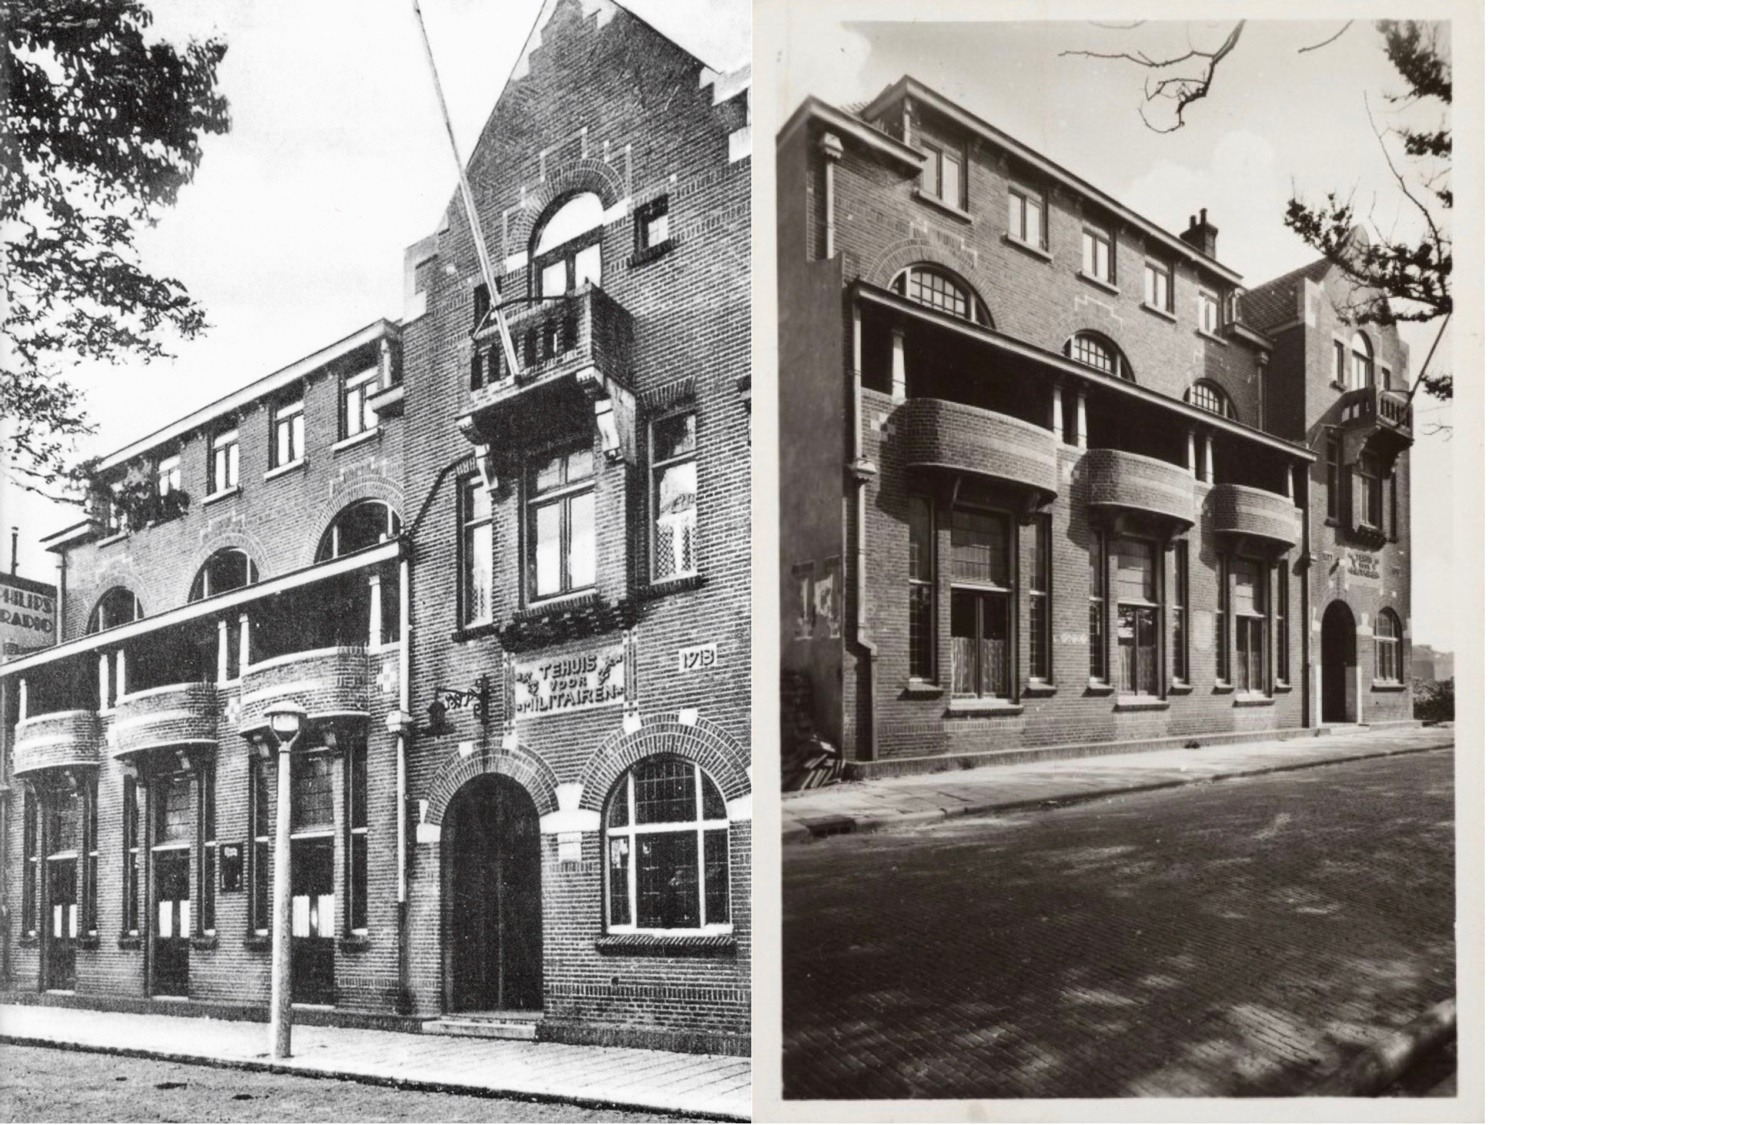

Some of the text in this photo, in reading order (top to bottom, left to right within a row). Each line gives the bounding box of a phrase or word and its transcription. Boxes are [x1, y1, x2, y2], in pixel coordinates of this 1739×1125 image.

[0, 609, 53, 633] RADIO
[539, 655, 598, 681] TEHUIS
[549, 676, 588, 692] VOOR
[524, 684, 617, 713] MILITAIREN
